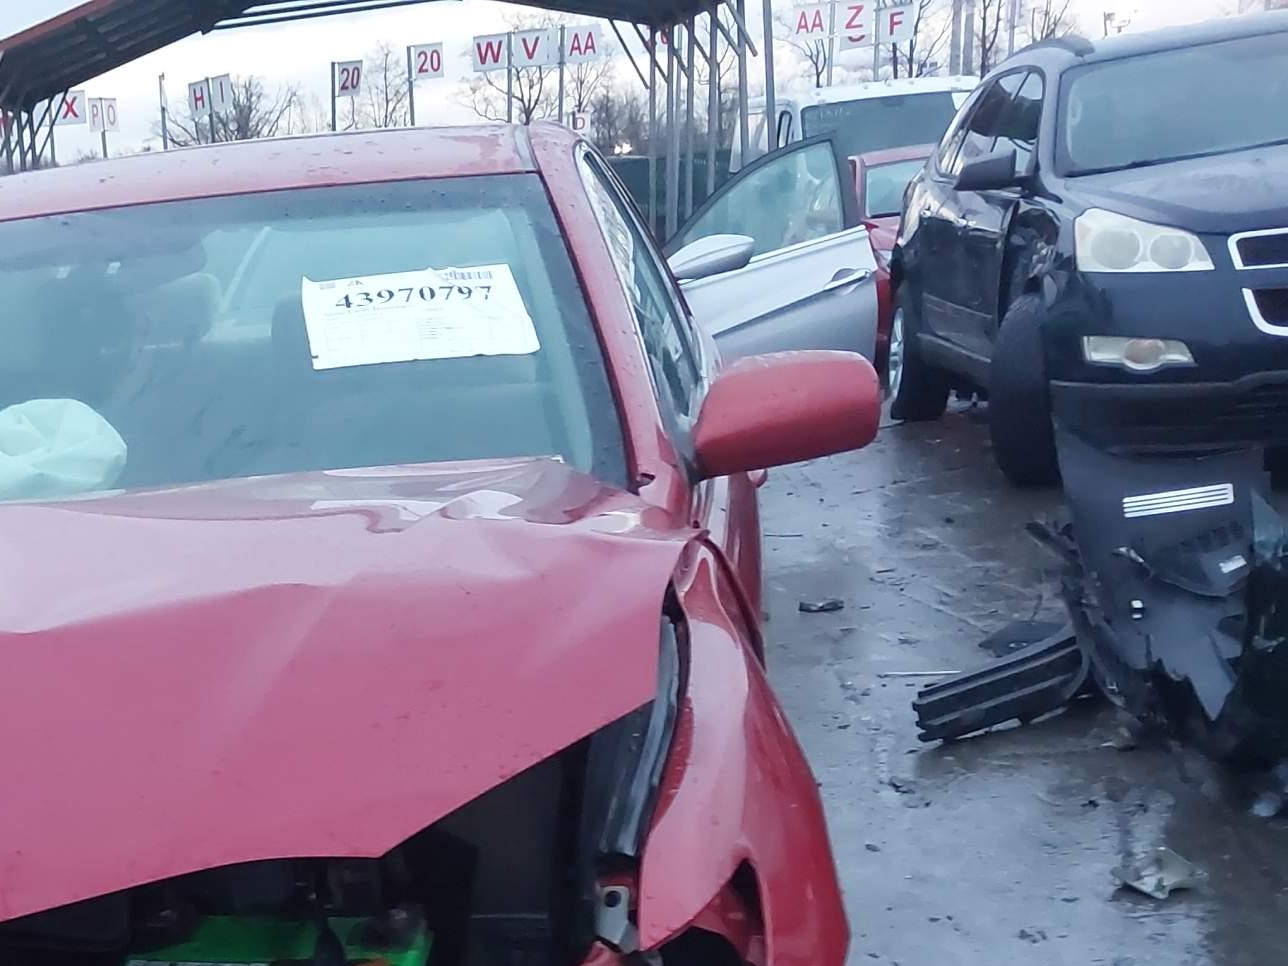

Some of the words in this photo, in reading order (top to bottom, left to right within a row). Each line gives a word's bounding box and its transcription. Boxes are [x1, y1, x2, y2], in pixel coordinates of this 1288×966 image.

[795, 9, 825, 34] AA
[845, 4, 864, 29] Z
[888, 11, 905, 36] F
[475, 40, 503, 65] W
[521, 36, 540, 60] V
[569, 31, 596, 56] AA
[417, 49, 441, 74] 20
[340, 67, 360, 91] 20
[62, 96, 79, 119] X
[192, 86, 205, 110] H
[335, 285, 492, 309] 43970797
